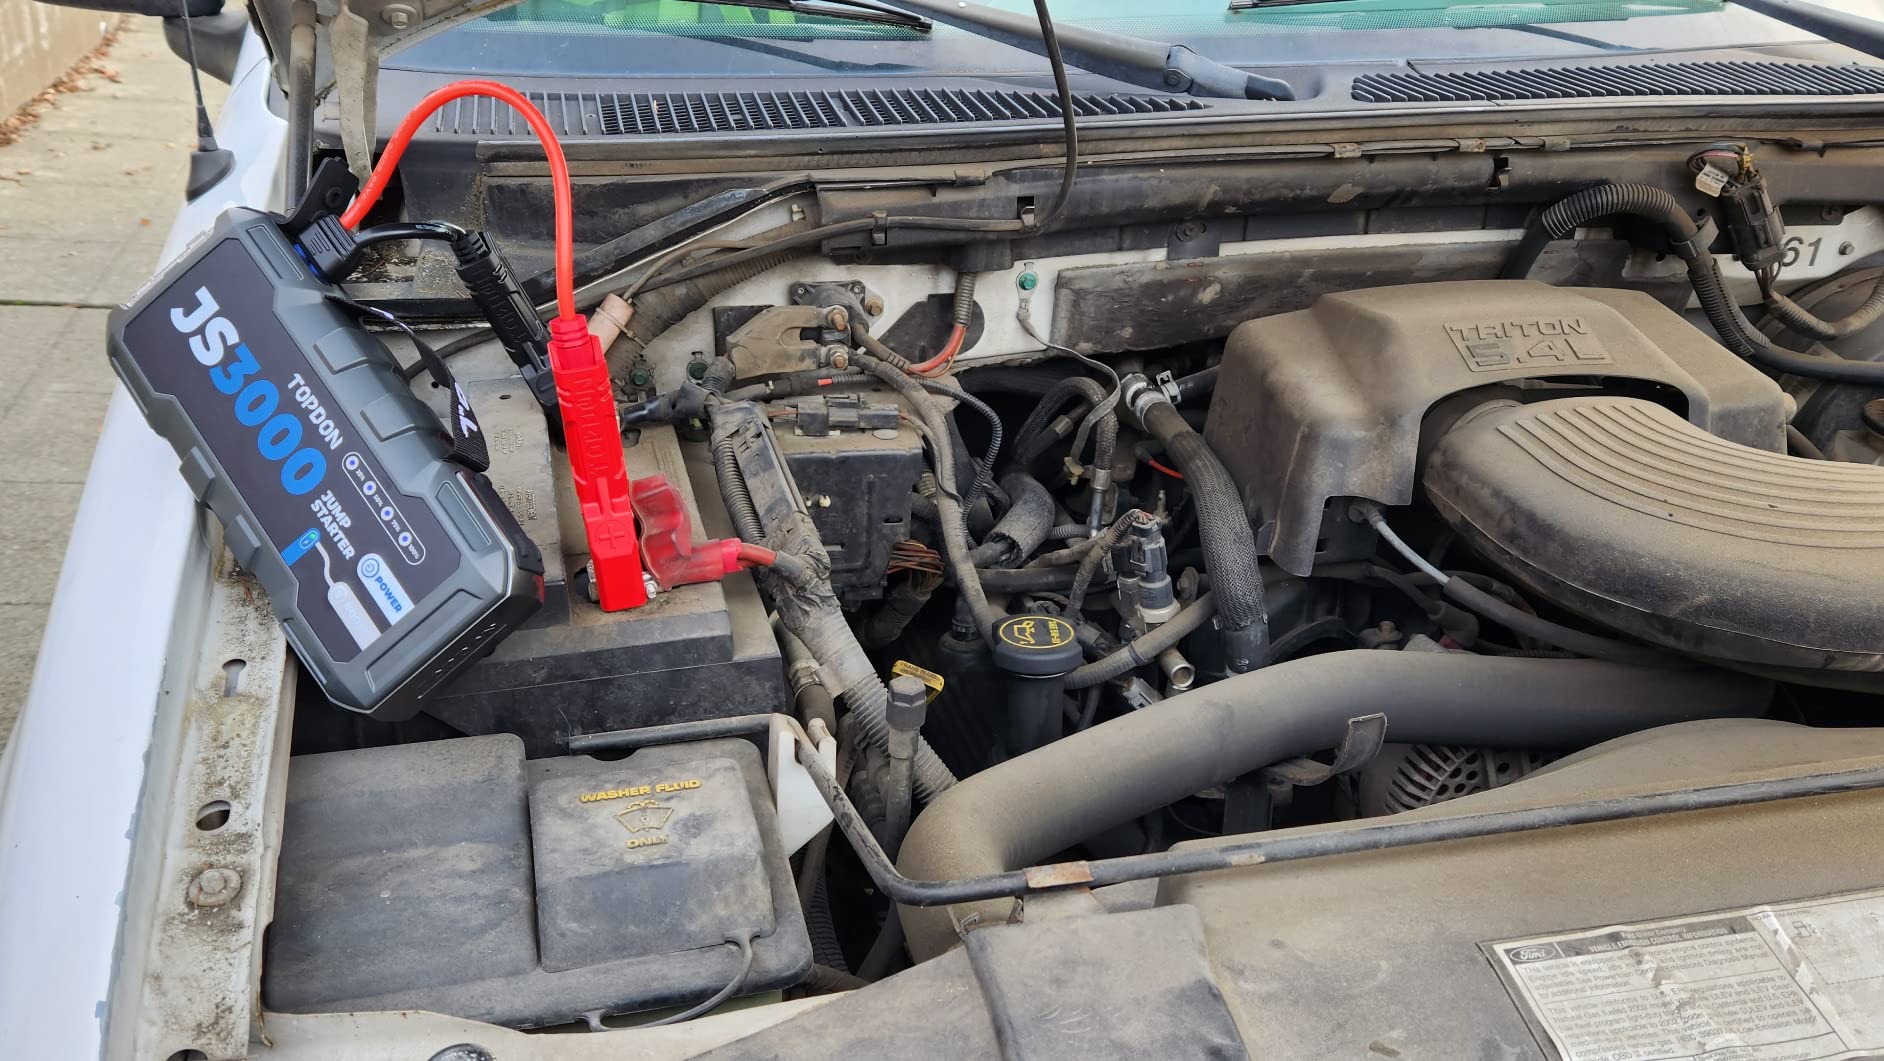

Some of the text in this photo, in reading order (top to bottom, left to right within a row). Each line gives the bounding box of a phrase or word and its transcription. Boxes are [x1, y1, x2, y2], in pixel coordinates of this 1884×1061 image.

[1451, 318, 1587, 341] TRITON
[1466, 339, 1606, 367] 5.4L
[170, 286, 326, 495] JS3000
[288, 373, 343, 450] TOPDON
[355, 469, 366, 482] 25%
[321, 490, 351, 528] JUMP
[372, 494, 384, 507] 50%
[311, 499, 355, 560] STARTER
[390, 519, 401, 532] 75%
[408, 544, 420, 560] 100%
[375, 576, 402, 613] POWER
[579, 779, 702, 803] WASHER FLUID
[626, 834, 671, 849] ONLY
[1588, 942, 1618, 952] VEHICLE
[1651, 935, 1682, 944] CONTROL
[1682, 928, 1727, 940] INFORMATION
[1518, 946, 1547, 960] Ford
[1628, 1003, 1648, 1012] 2002
[1658, 1018, 1679, 1027] 2002
